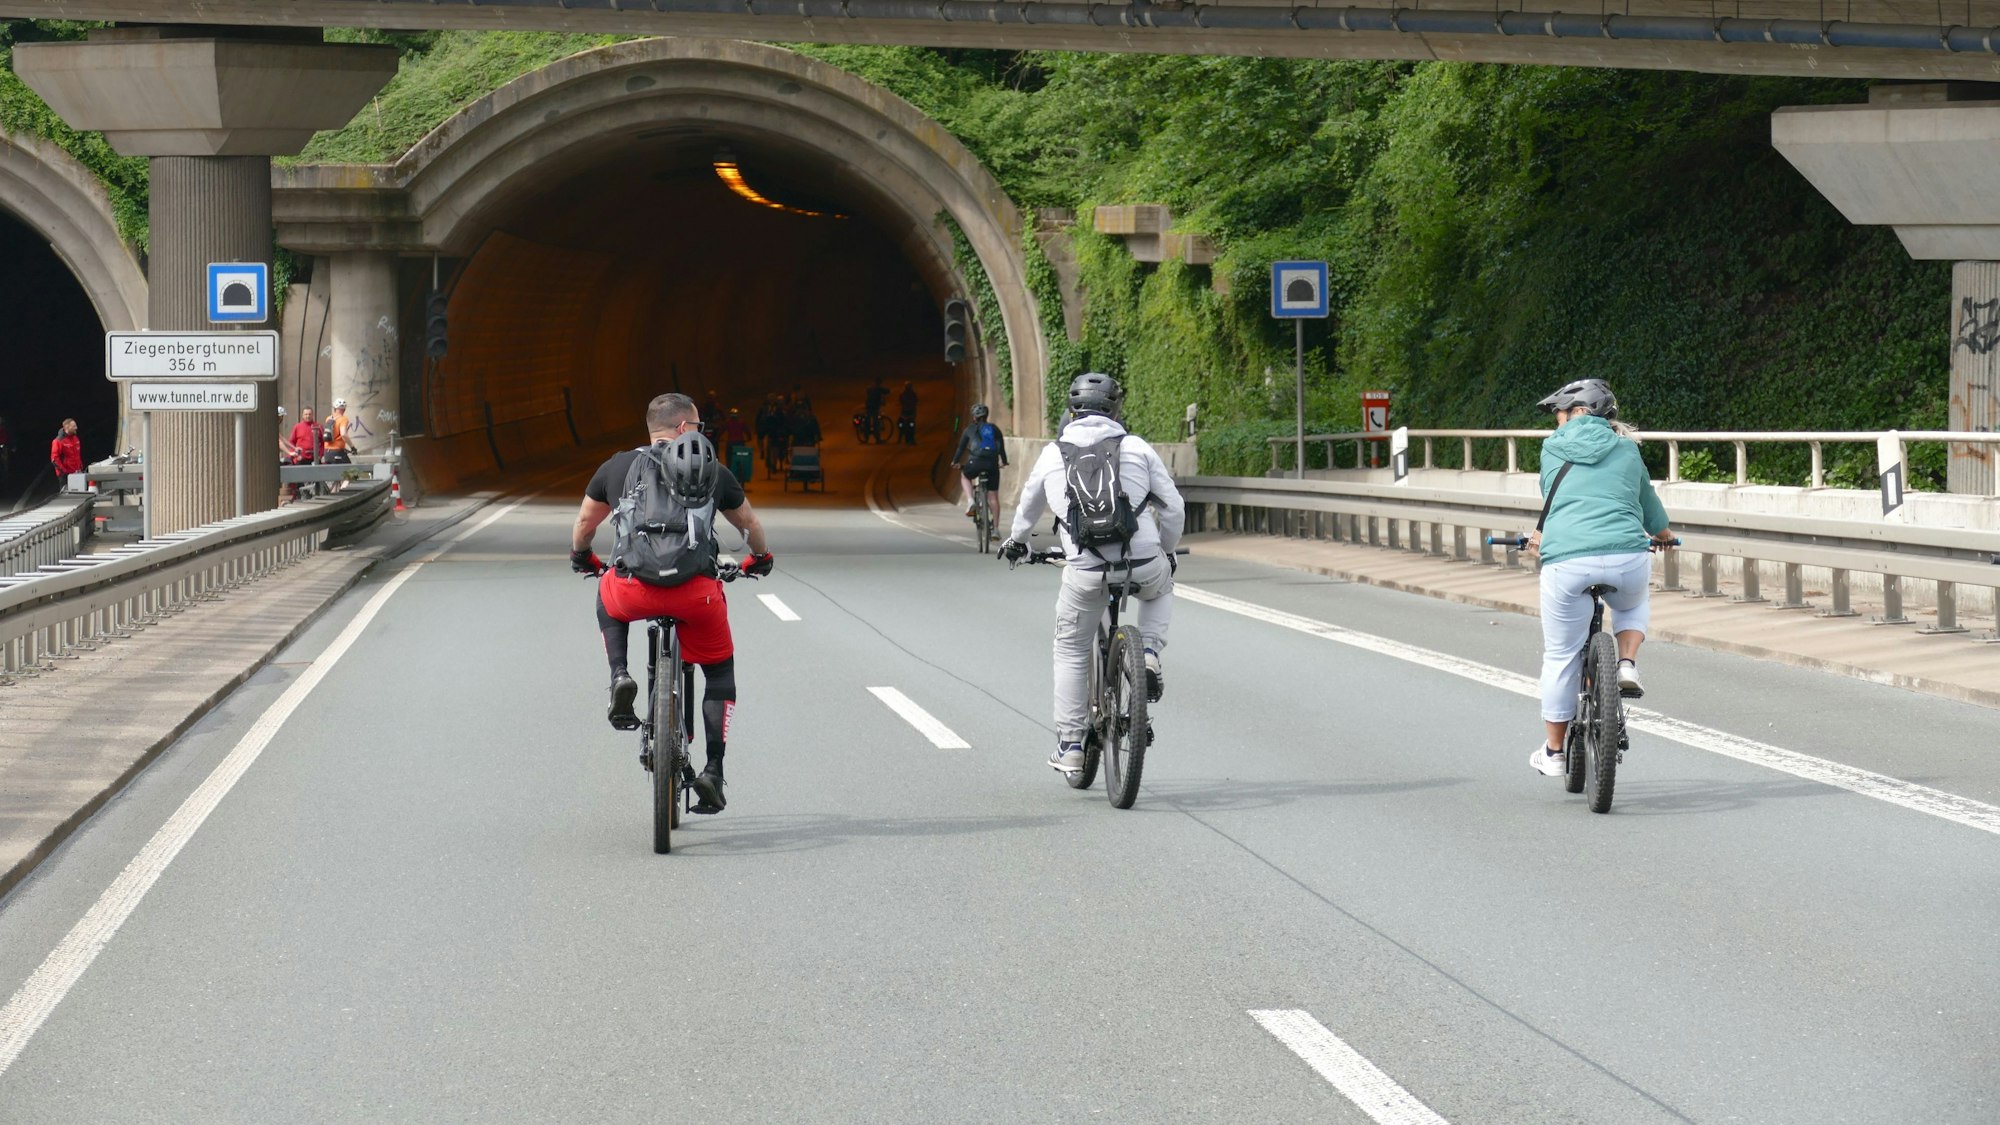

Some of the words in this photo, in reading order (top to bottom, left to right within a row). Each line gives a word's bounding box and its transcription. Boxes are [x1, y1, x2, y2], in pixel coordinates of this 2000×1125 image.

[124, 341, 261, 358] Ziegenbergtunnel
[169, 358, 195, 371] 356
[203, 361, 217, 371] m
[138, 390, 249, 404] www.tunnel.nrw.de
